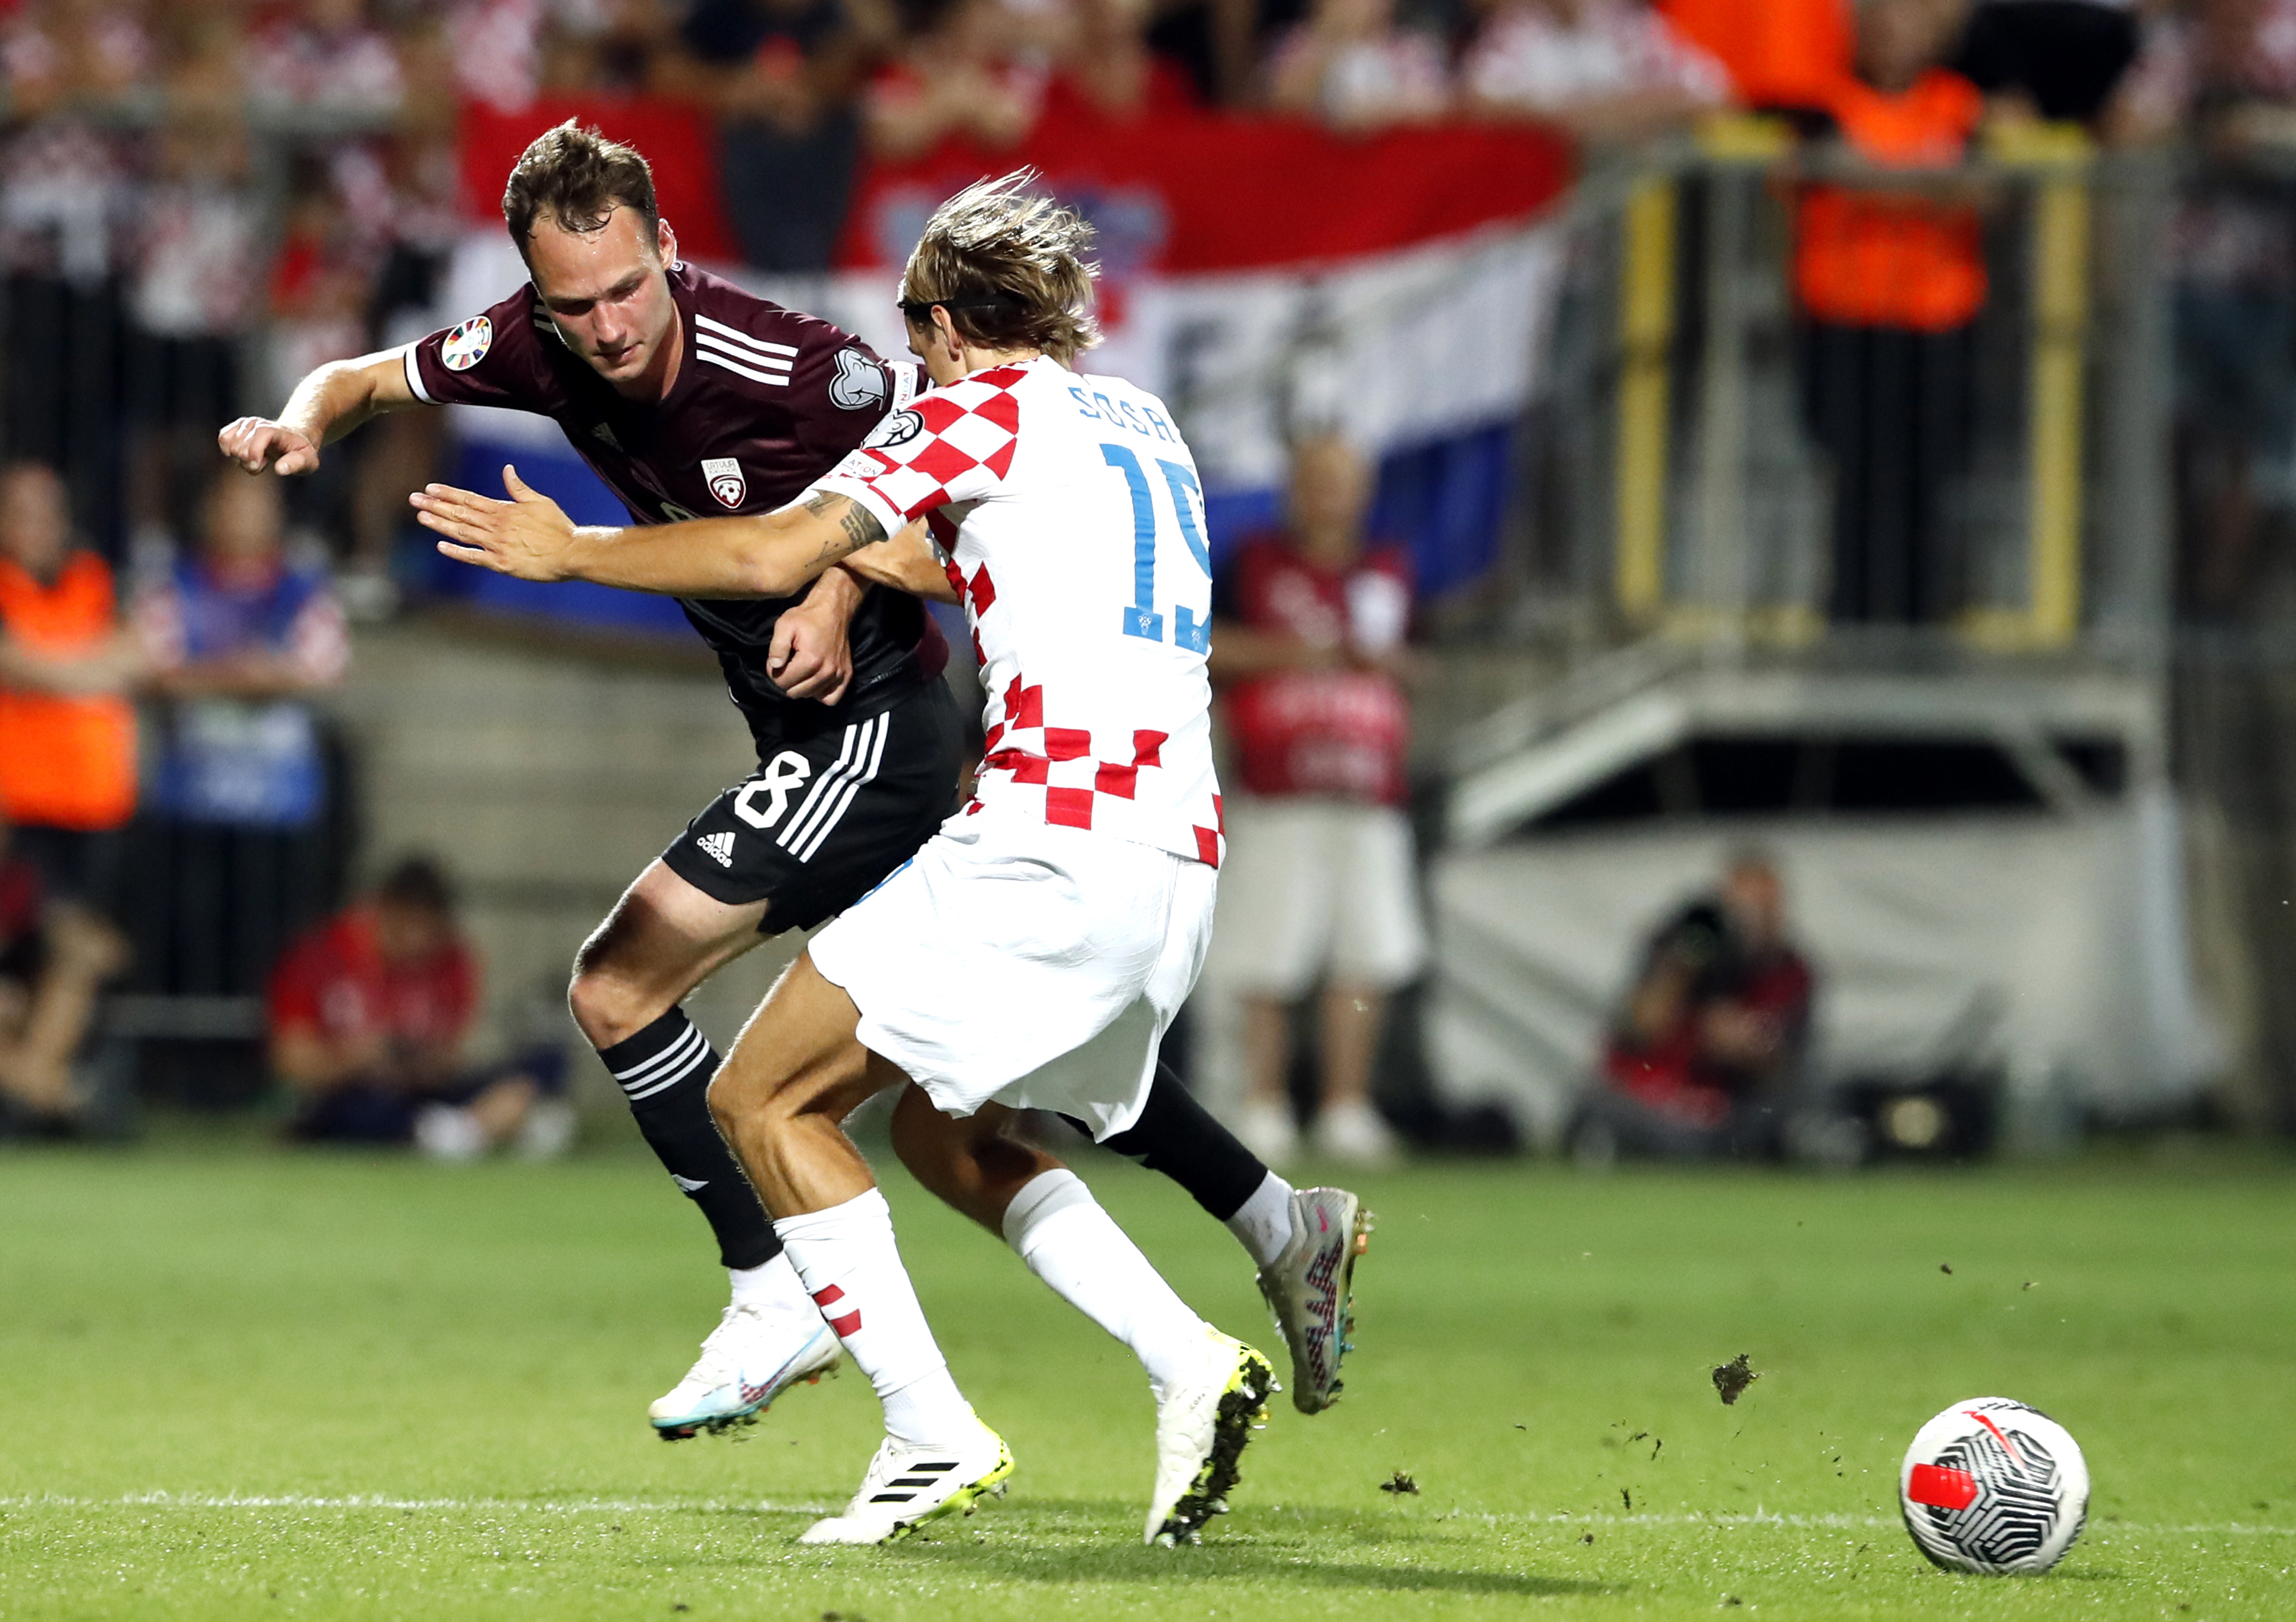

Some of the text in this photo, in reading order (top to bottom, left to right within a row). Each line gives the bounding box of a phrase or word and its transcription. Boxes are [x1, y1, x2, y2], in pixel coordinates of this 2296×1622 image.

[1067, 387, 1177, 444] SOSA
[1099, 443, 1211, 656] 15
[734, 751, 811, 829] 8
[696, 836, 733, 868] adidas
